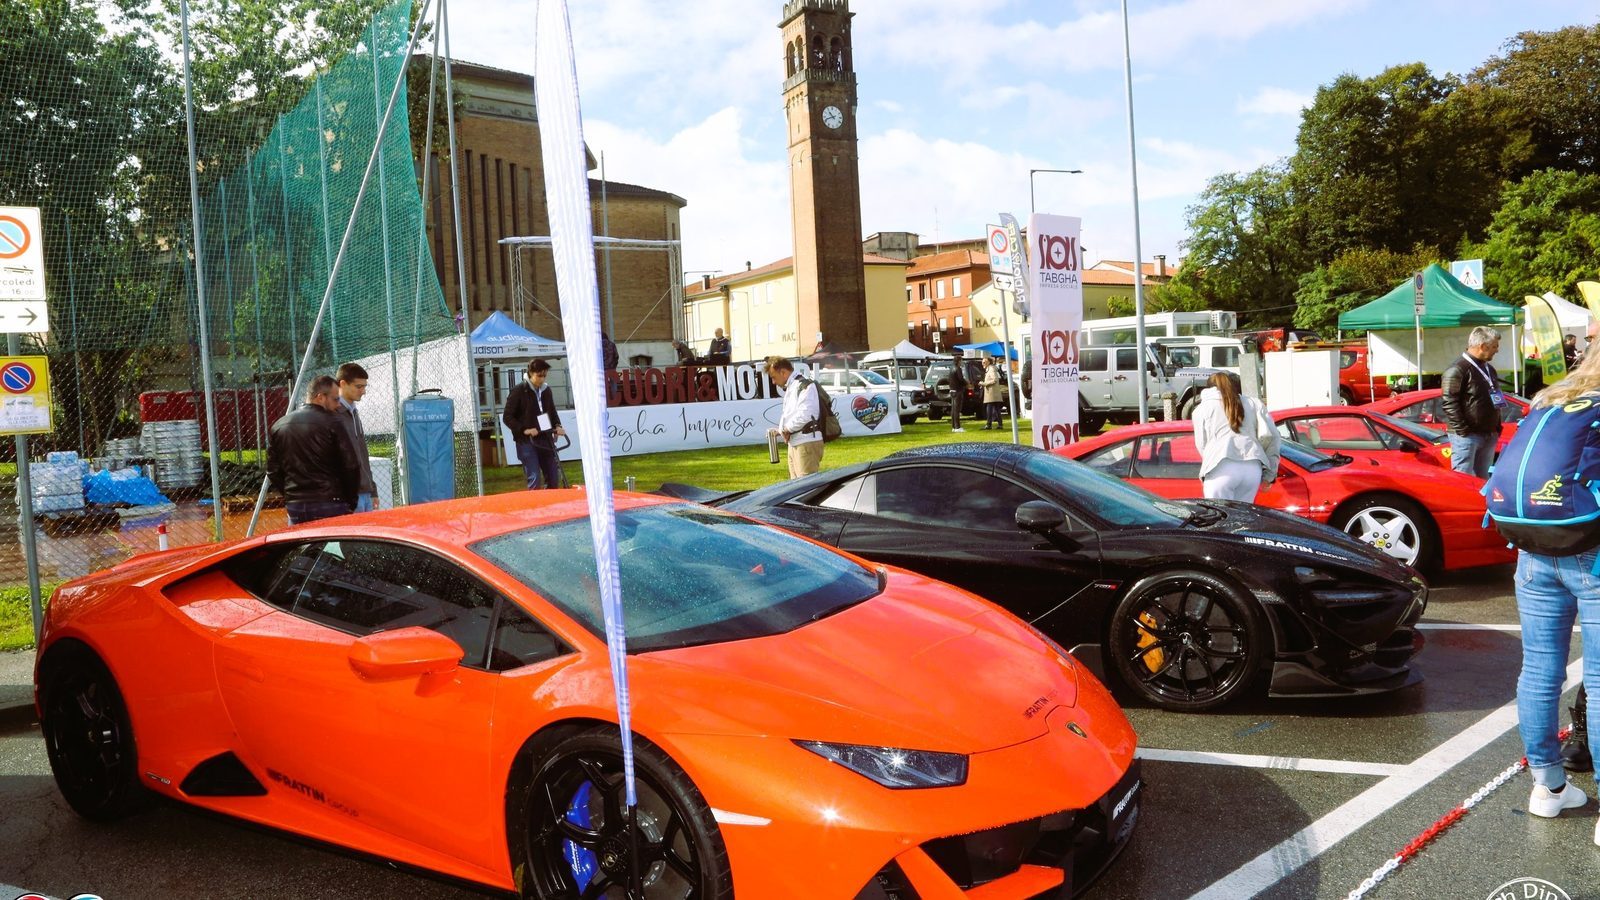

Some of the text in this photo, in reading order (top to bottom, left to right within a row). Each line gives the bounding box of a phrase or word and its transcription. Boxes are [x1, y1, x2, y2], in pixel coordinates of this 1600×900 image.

[1039, 271, 1078, 284] TABGHA
[486, 333, 538, 342] audison
[473, 345, 504, 354] udison
[682, 407, 755, 443] Impresa
[275, 772, 326, 804] FRATTIN
